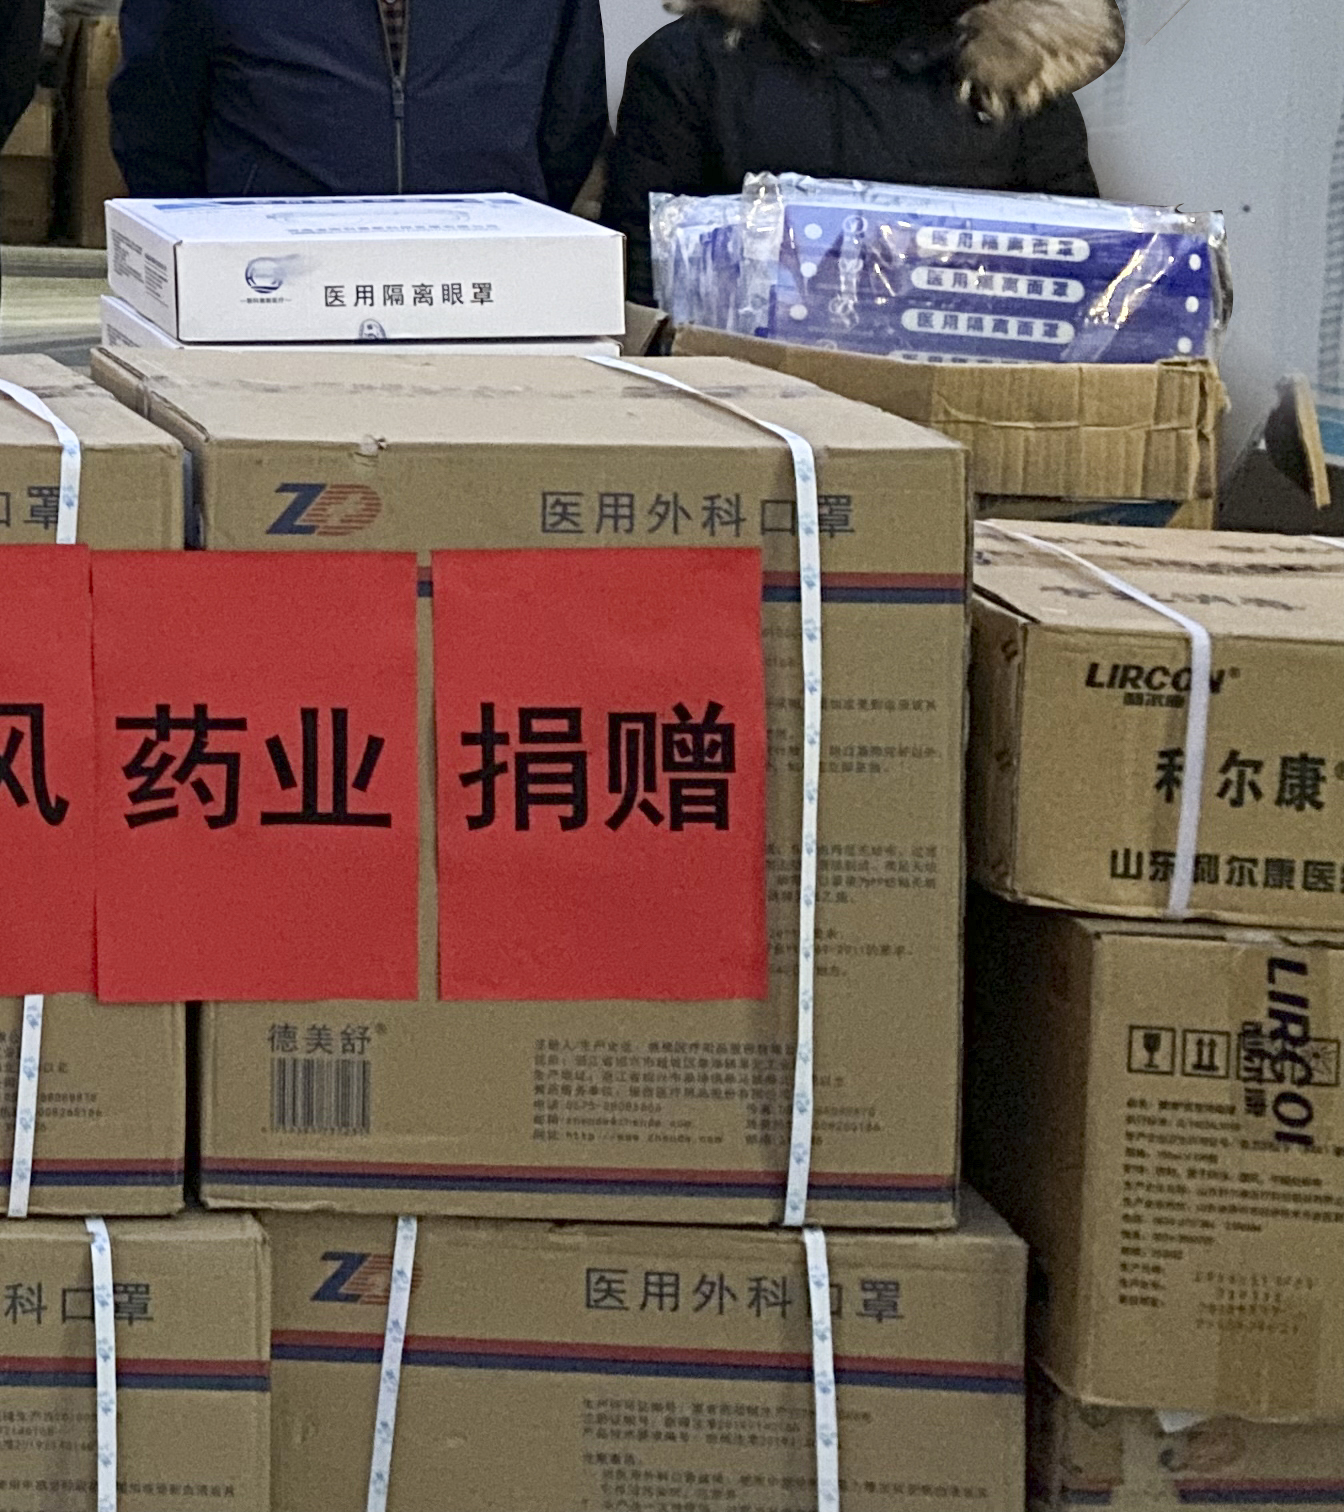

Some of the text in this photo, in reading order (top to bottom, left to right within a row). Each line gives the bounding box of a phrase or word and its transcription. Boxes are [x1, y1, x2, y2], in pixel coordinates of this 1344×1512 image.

[324, 282, 494, 308] 医用隔离眼罩
[539, 489, 856, 540] 医用外科口罩
[1110, 848, 1344, 894] 山东利尔康医
[268, 1022, 372, 1054] 德美舒
